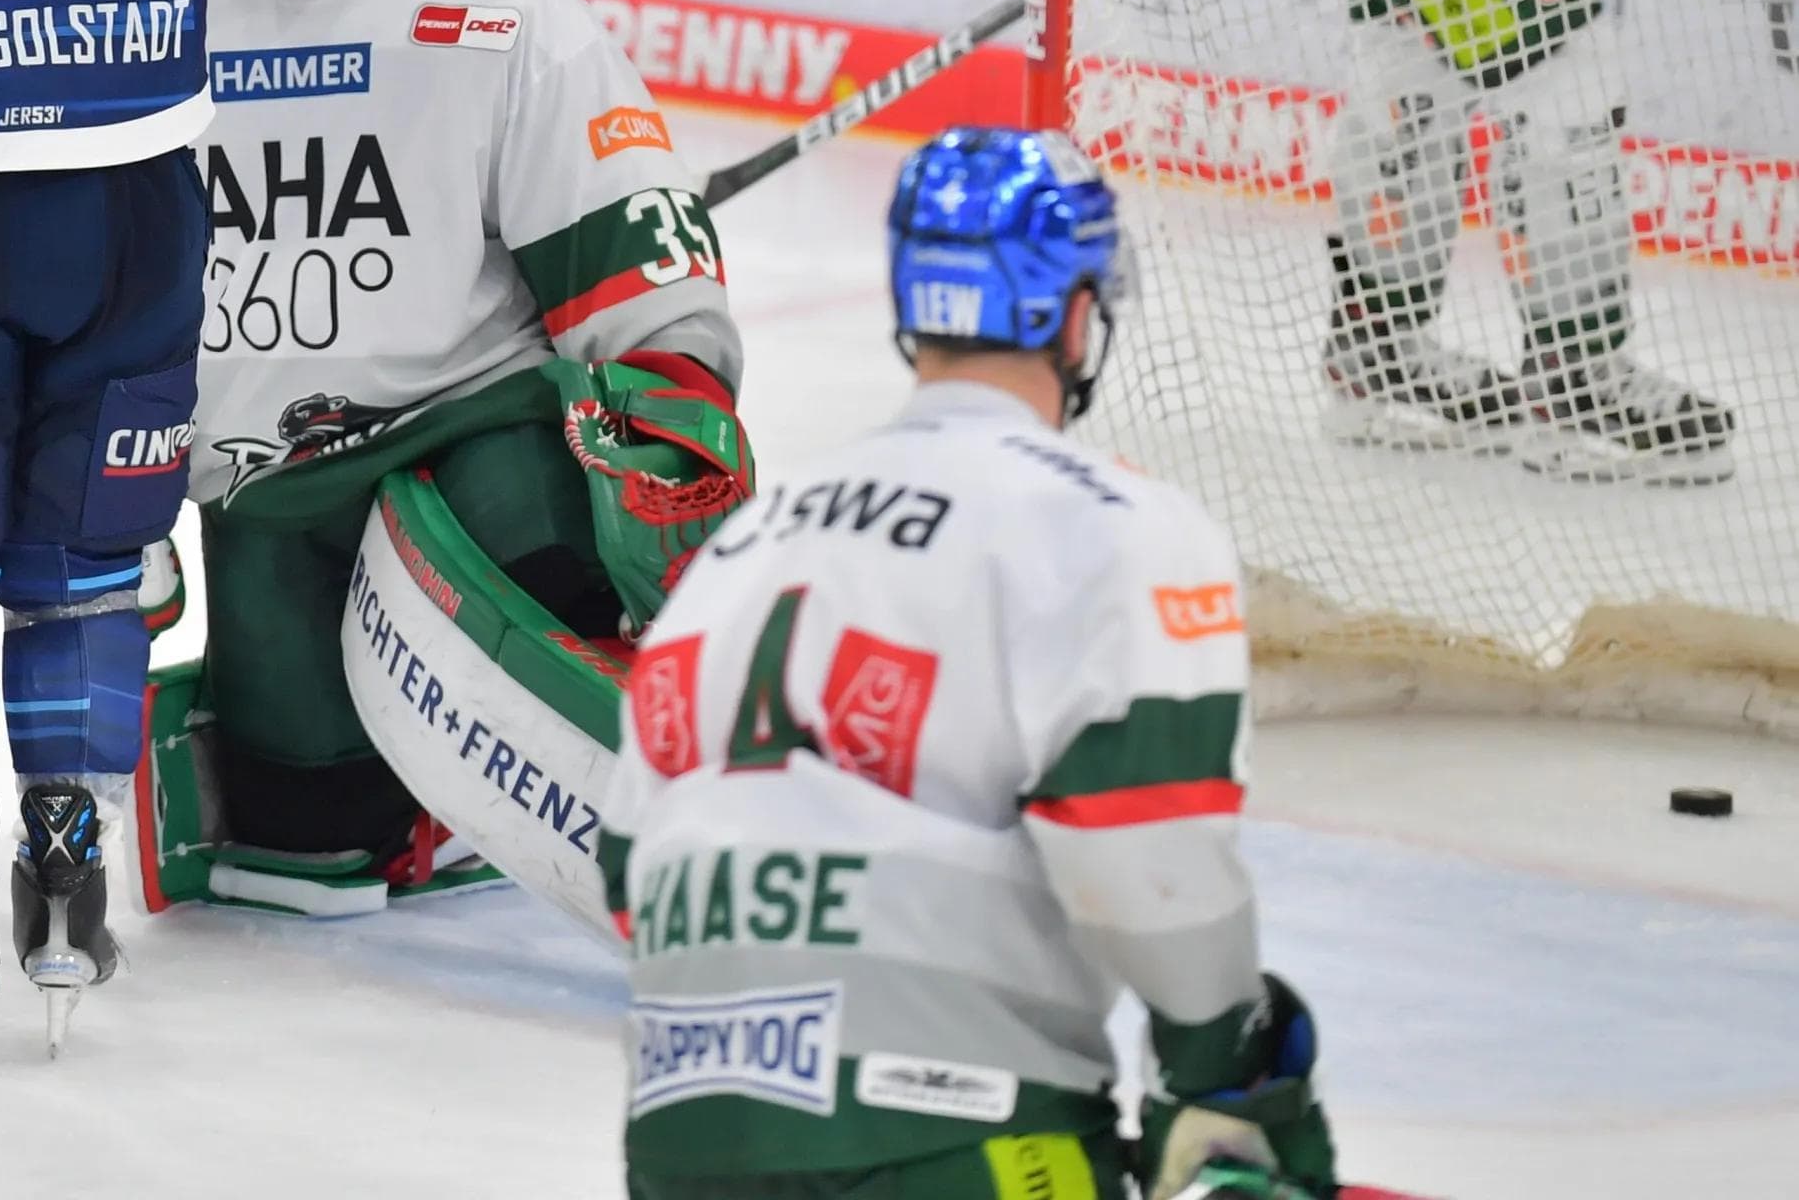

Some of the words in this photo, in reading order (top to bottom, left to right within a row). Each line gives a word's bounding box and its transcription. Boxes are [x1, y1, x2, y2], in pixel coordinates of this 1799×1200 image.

[214, 52, 364, 93] HAIMER
[626, 187, 718, 287] 35
[350, 553, 602, 856] RICHTER+FRENZ
[634, 848, 868, 955] HAASE
